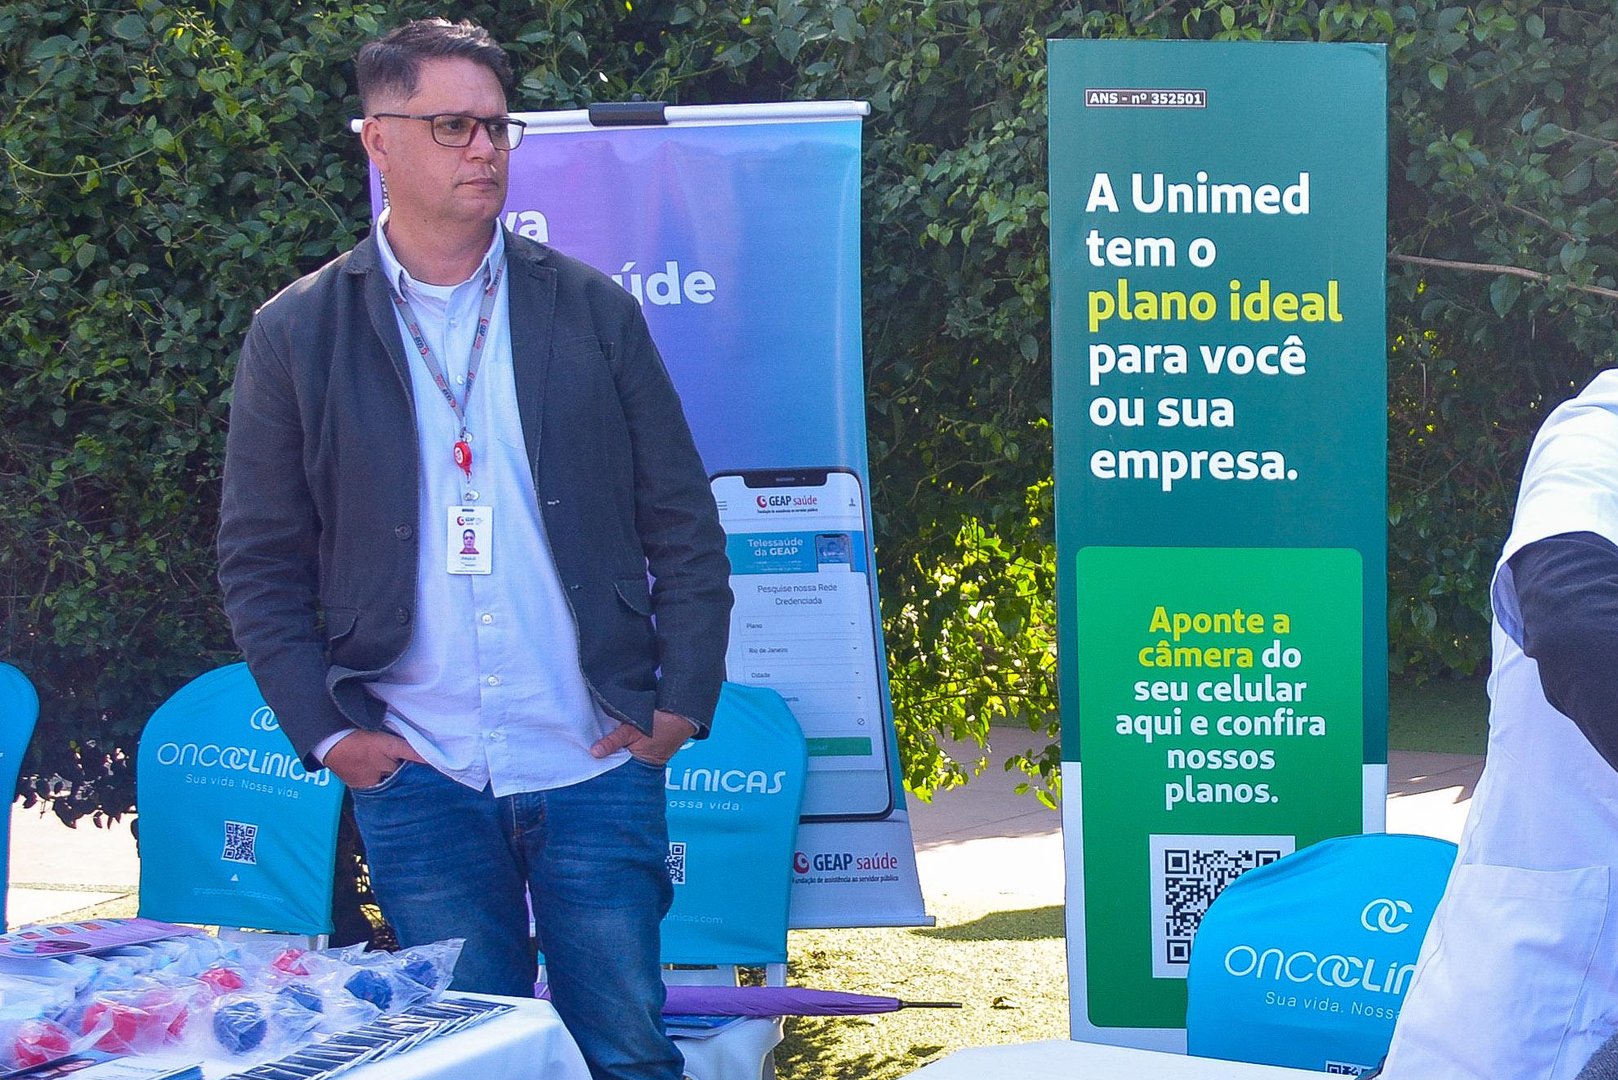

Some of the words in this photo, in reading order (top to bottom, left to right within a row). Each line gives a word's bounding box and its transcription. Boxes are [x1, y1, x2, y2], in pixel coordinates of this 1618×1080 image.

[1089, 92, 1119, 105] ANS
[1151, 93, 1202, 106] 352501
[1085, 172, 1119, 214] A
[1131, 171, 1310, 215] Unimed
[1086, 231, 1175, 267] tem
[1188, 237, 1216, 268] o
[1088, 279, 1216, 332] plano
[1229, 279, 1344, 323] ideal
[1088, 344, 1188, 386] para
[1199, 335, 1307, 375] você
[1088, 400, 1145, 426] ou
[1157, 400, 1235, 427] sua
[1090, 448, 1299, 491] empresa.
[769, 496, 792, 506] GEAP
[793, 495, 817, 505] saúde
[747, 538, 803, 547] Telessaúde
[770, 548, 799, 556] GEAP
[758, 586, 792, 594] Pesquise
[794, 584, 816, 592] nossa
[819, 584, 837, 592] Rede
[775, 597, 822, 605] Credenciada
[1148, 606, 1265, 641] Aponte
[1273, 614, 1290, 634] a
[1138, 641, 1254, 669] câmera
[1261, 640, 1302, 669] do
[1134, 681, 1188, 703] seu
[1196, 675, 1307, 703] celular
[1115, 709, 1181, 743] aqui
[1190, 715, 1208, 737] e
[1217, 708, 1326, 737] confira
[1167, 748, 1275, 769] nossos
[185, 774, 207, 784] Sua
[242, 779, 274, 793] Nossa
[664, 768, 786, 794] LÍNICAS
[1165, 776, 1279, 811] planos.
[669, 800, 703, 809] ossa
[813, 853, 853, 871] GEAP
[857, 852, 897, 869] saúde
[1225, 945, 1417, 995] ONCOCLÍN
[1265, 992, 1297, 1007] Sua
[1304, 996, 1344, 1013] vida.
